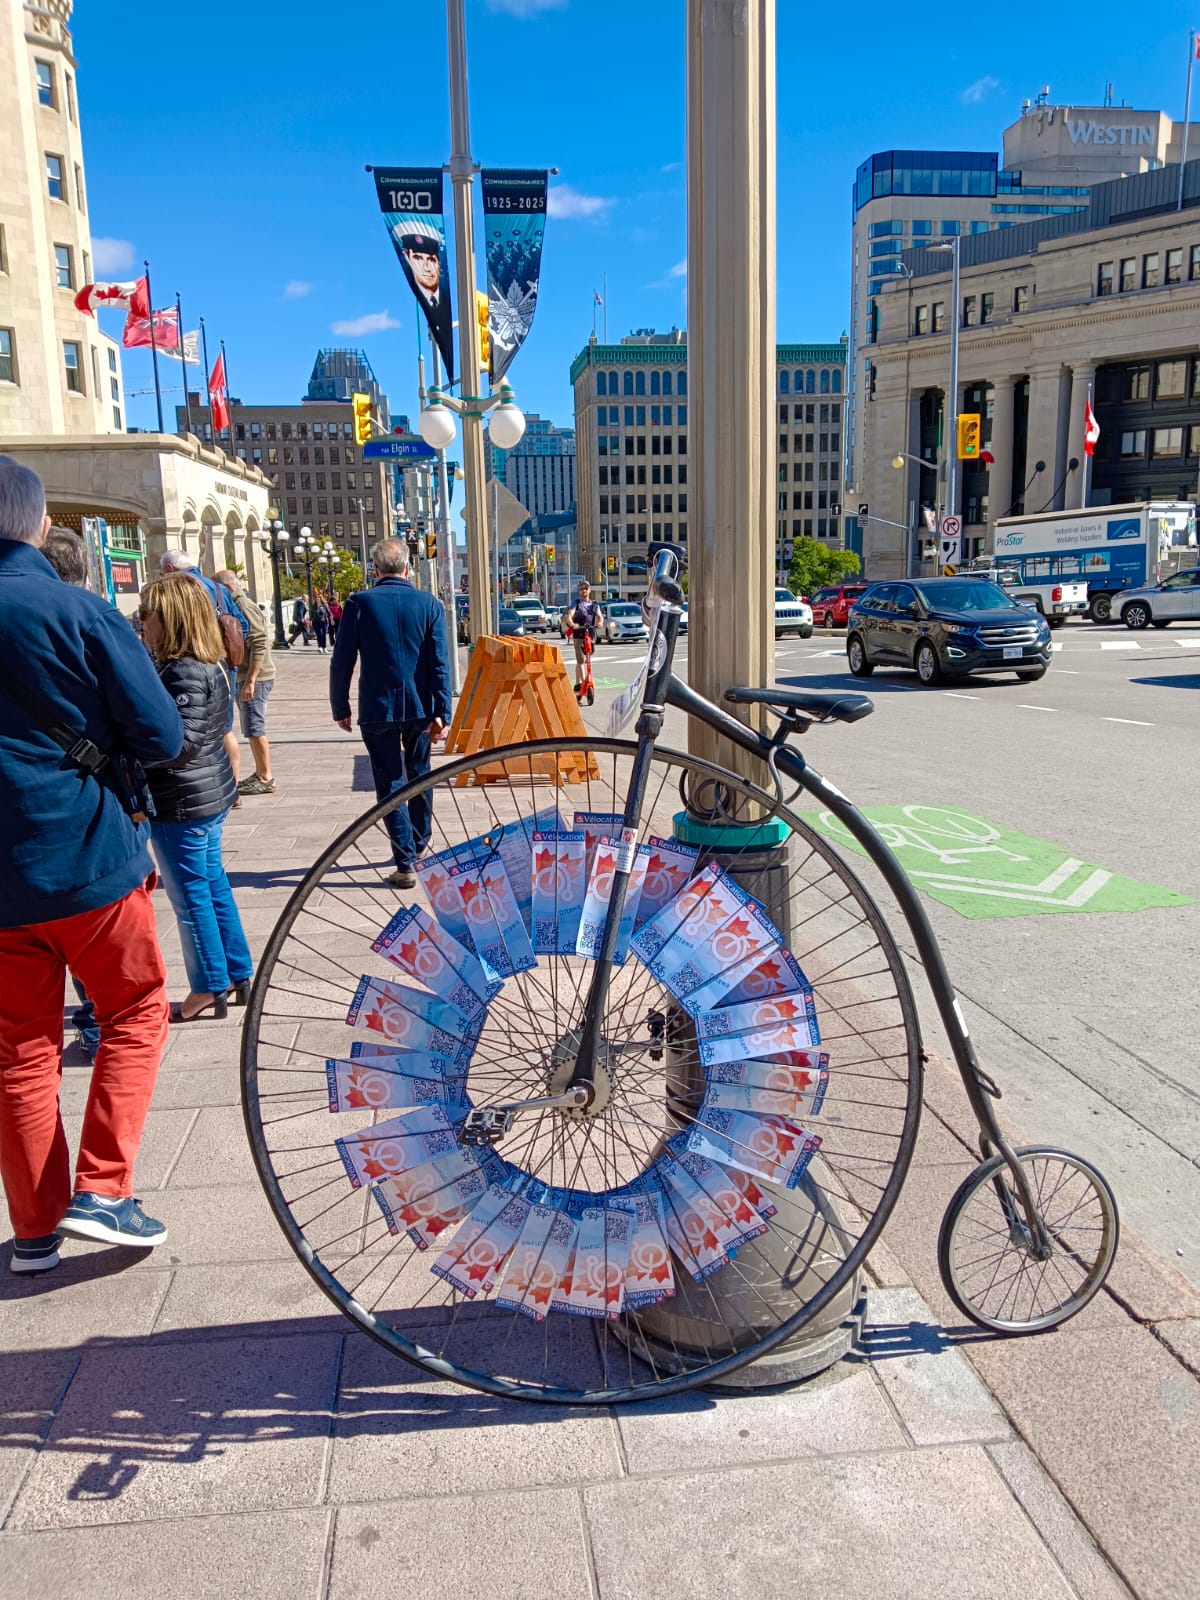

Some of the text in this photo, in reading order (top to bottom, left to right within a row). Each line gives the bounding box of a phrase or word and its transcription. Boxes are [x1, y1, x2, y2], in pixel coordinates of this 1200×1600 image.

[1067, 120, 1154, 145] WESTIN
[391, 442, 410, 456] Elgin
[996, 535, 1025, 547] ProStar
[585, 815, 624, 824] Vélocaton
[658, 840, 697, 859] RentABike
[388, 905, 420, 940] RentABke
[806, 1003, 821, 1044] Véocation
[811, 1079, 827, 1115] Véloation
[372, 1187, 396, 1226] Véocation
[725, 1229, 760, 1252] RenABike
